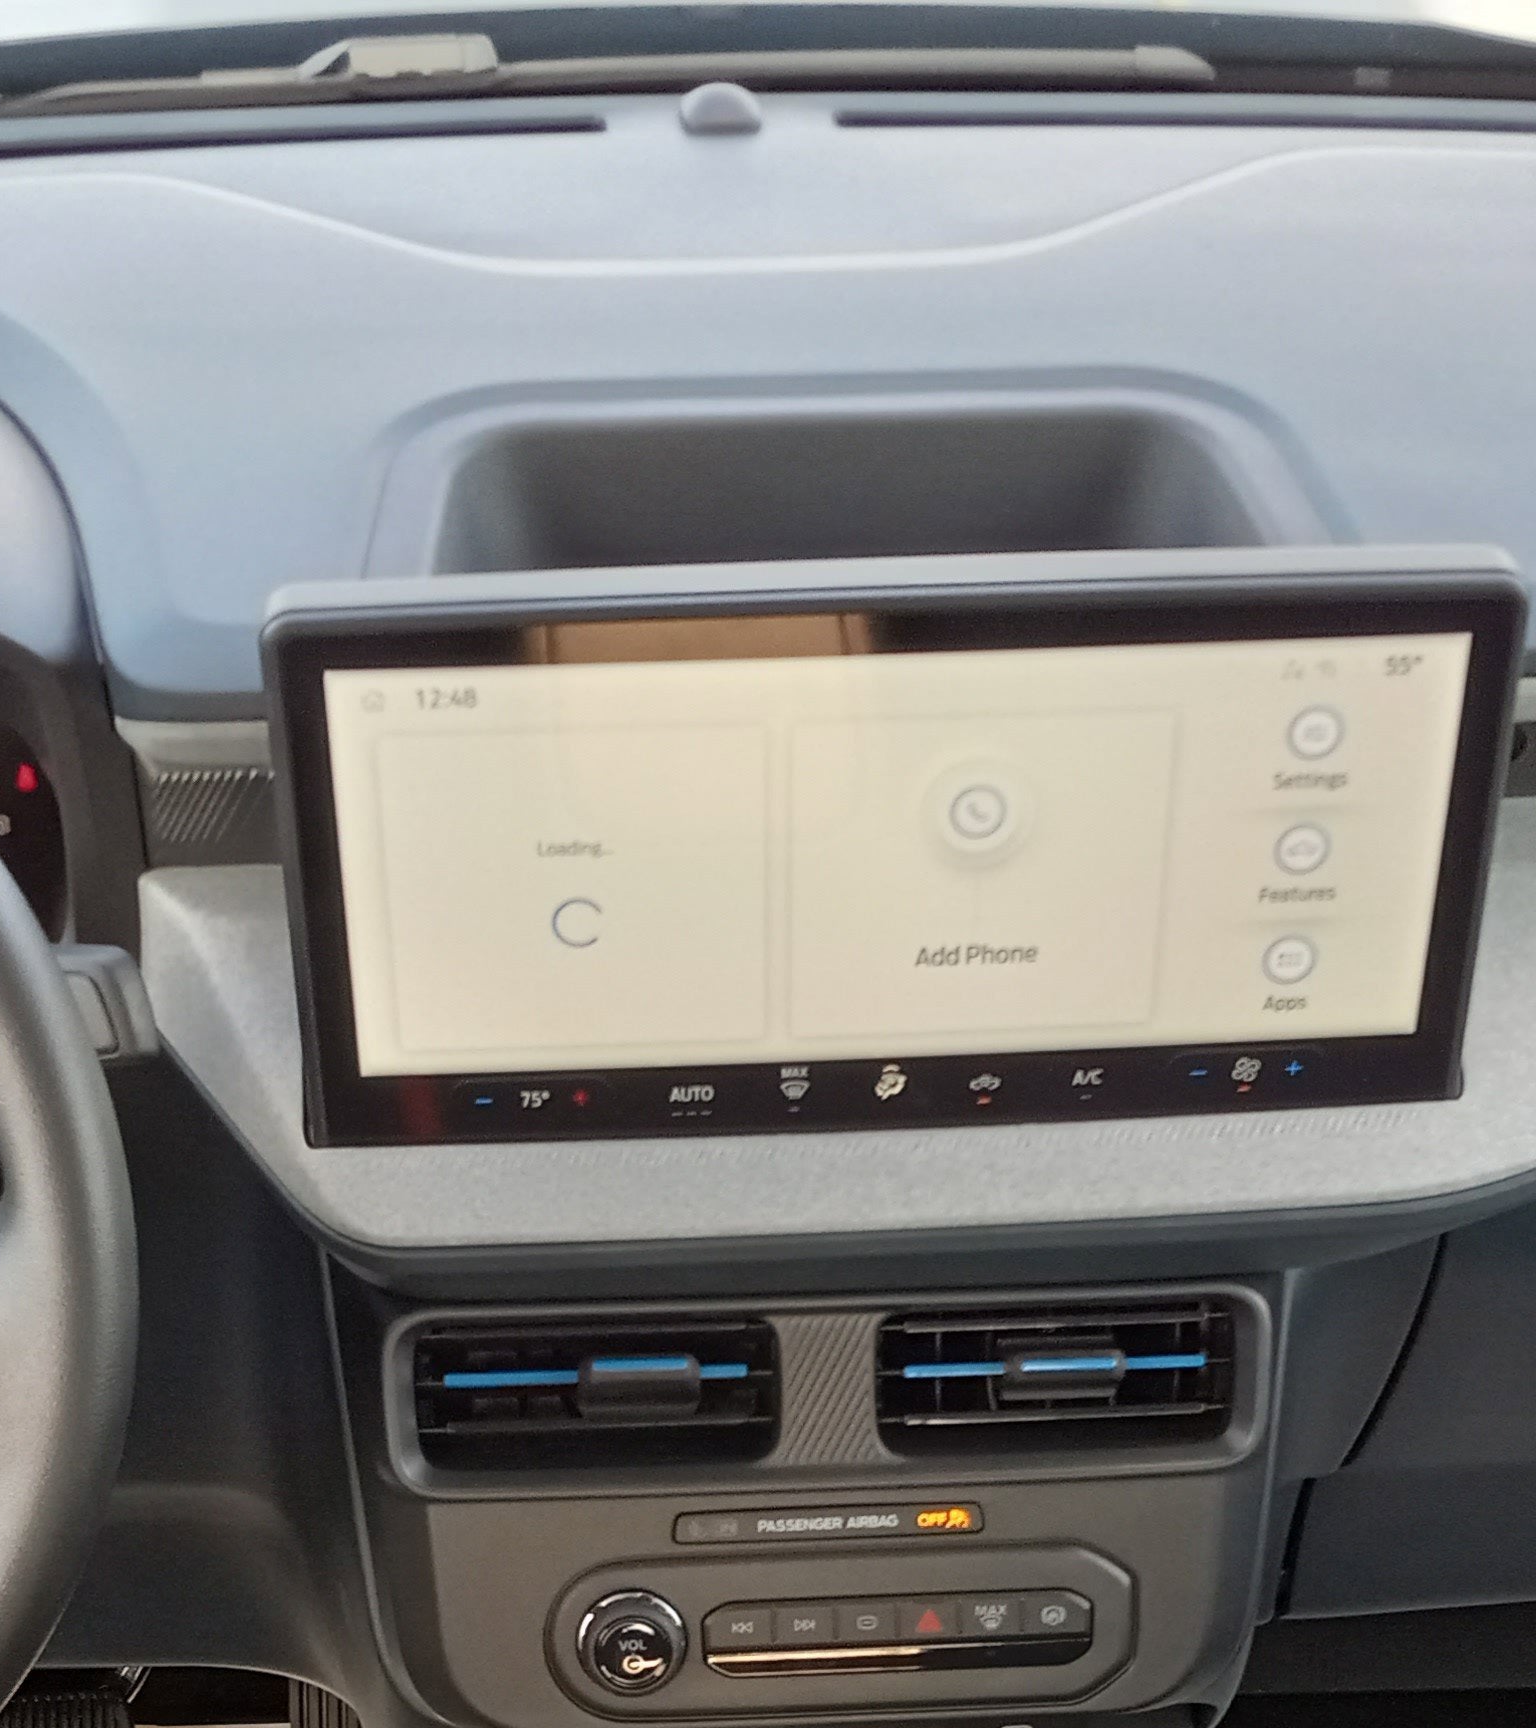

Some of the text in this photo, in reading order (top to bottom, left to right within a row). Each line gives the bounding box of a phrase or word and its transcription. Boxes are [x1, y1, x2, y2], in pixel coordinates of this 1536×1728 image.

[1273, 768, 1349, 793] Settings
[1258, 882, 1336, 903] Features
[915, 942, 1038, 969] Add Phone
[1263, 993, 1307, 1014] Apps
[1072, 1067, 1104, 1088] A/C
[669, 1085, 714, 1104] AUTO
[757, 1517, 842, 1533] PASSENGER
[845, 1513, 900, 1530] AIRBAG
[916, 1511, 948, 1529] OFF
[974, 1604, 1007, 1616] MAX
[618, 1638, 648, 1655] VOL
